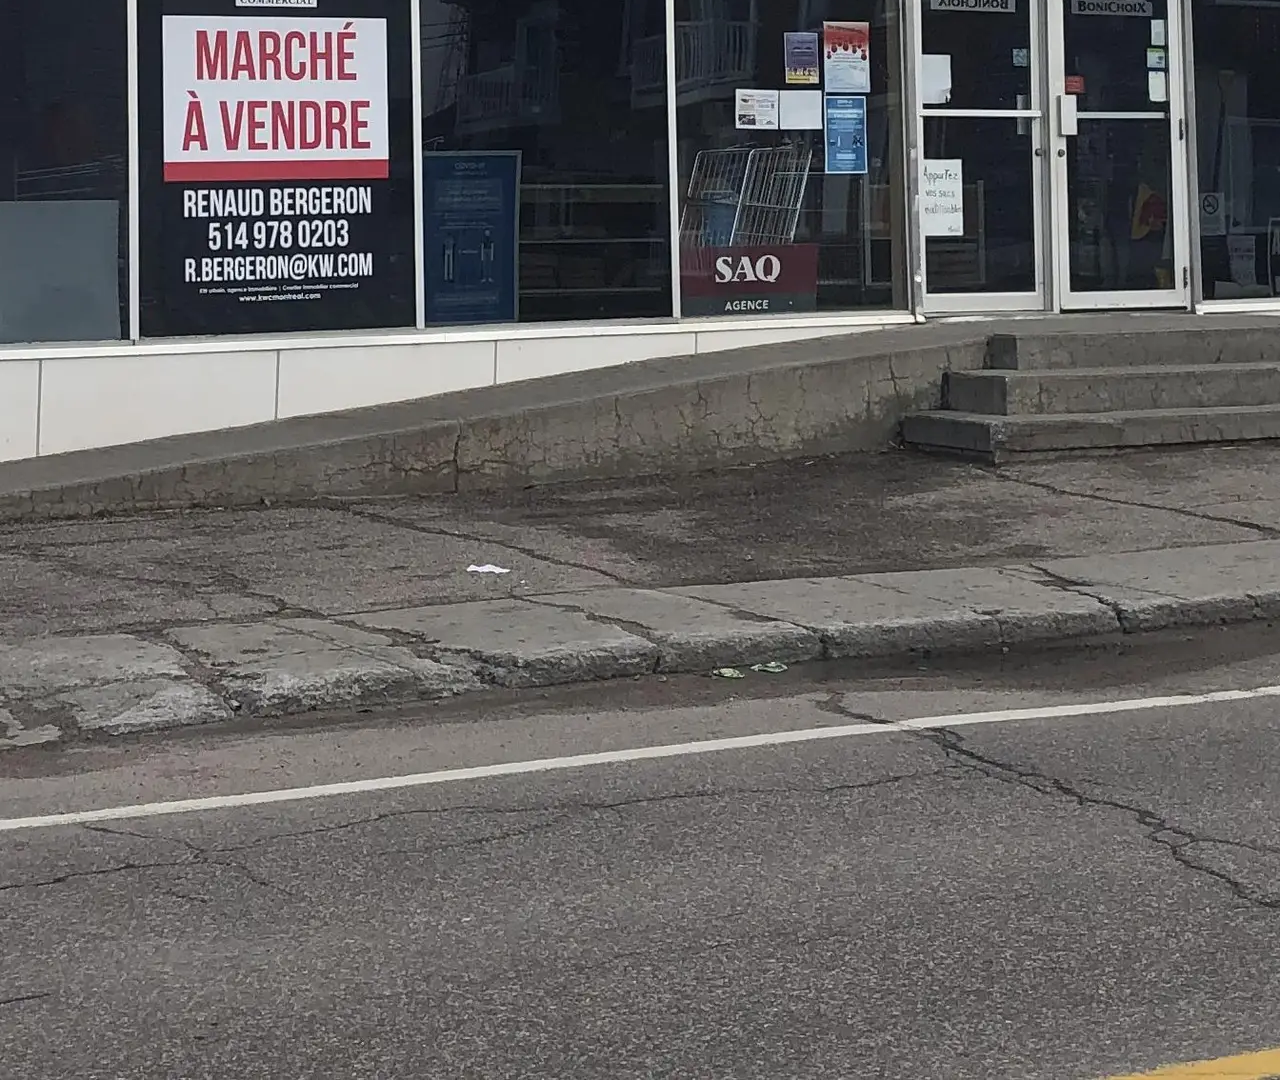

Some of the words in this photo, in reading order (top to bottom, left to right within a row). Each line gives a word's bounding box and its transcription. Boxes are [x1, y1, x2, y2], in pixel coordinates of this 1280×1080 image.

[195, 21, 358, 81] MARCHÉ
[182, 90, 208, 151] À
[219, 99, 372, 152] VENDRE
[183, 189, 264, 218] RENAUD
[269, 186, 372, 216] BERGERON
[208, 222, 249, 250] 514
[254, 220, 291, 249] 978
[297, 219, 350, 248] 0203
[184, 252, 373, 283] R.BERGERON@KW.COM
[714, 254, 781, 284] SAQ
[724, 299, 769, 311] AGENCE
